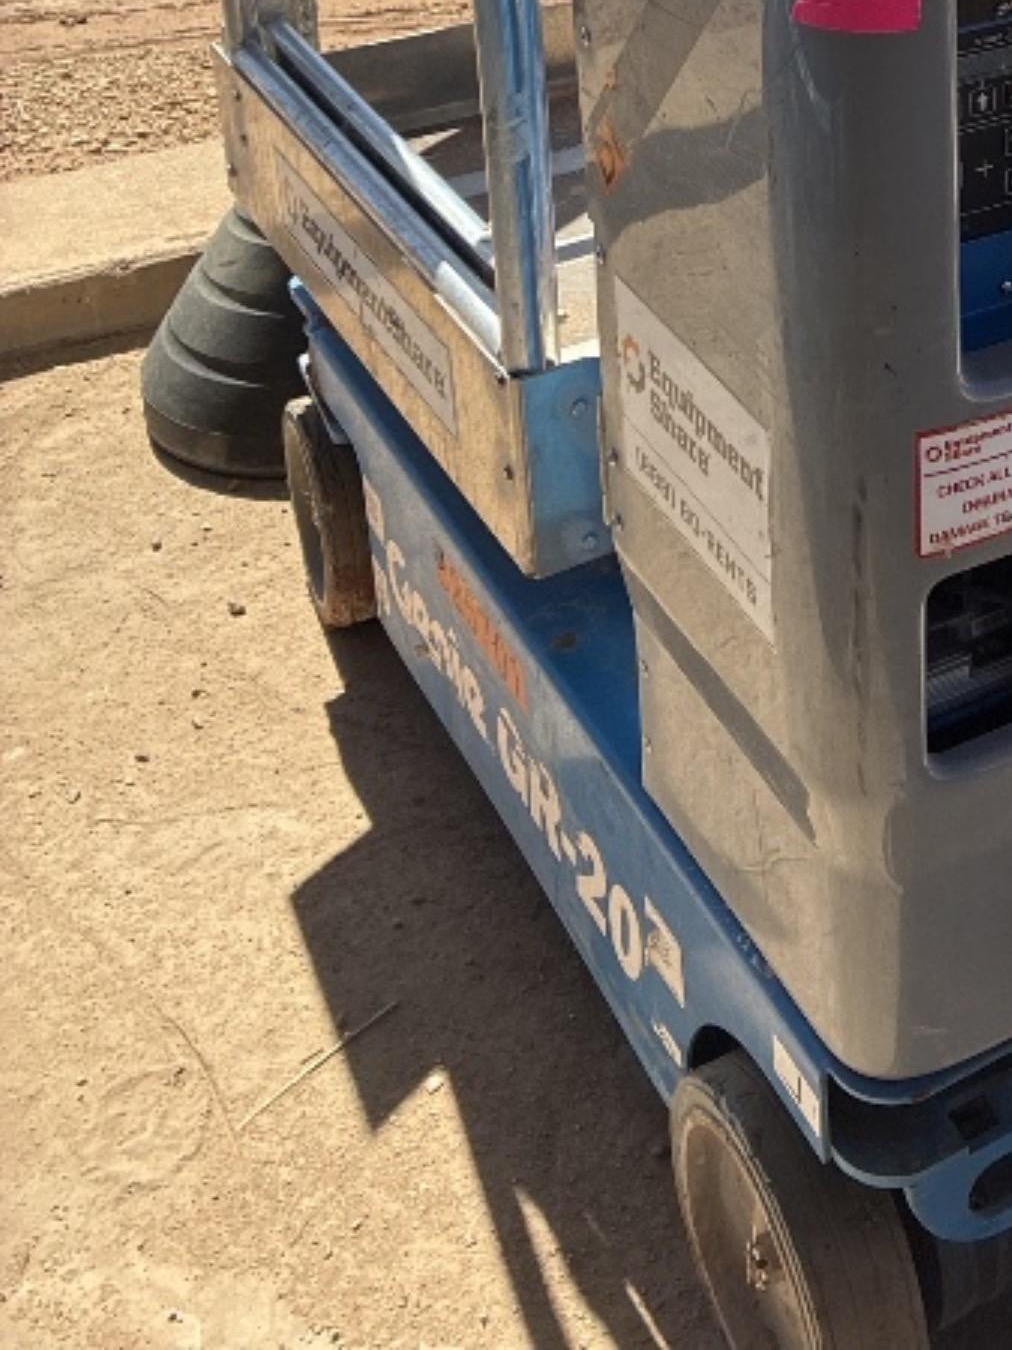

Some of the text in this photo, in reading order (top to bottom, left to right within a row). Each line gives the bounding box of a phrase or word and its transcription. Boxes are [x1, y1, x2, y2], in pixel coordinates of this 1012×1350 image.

[648, 351, 765, 502] Equipment
[648, 389, 710, 478] Share
[497, 707, 644, 983] GR-20
